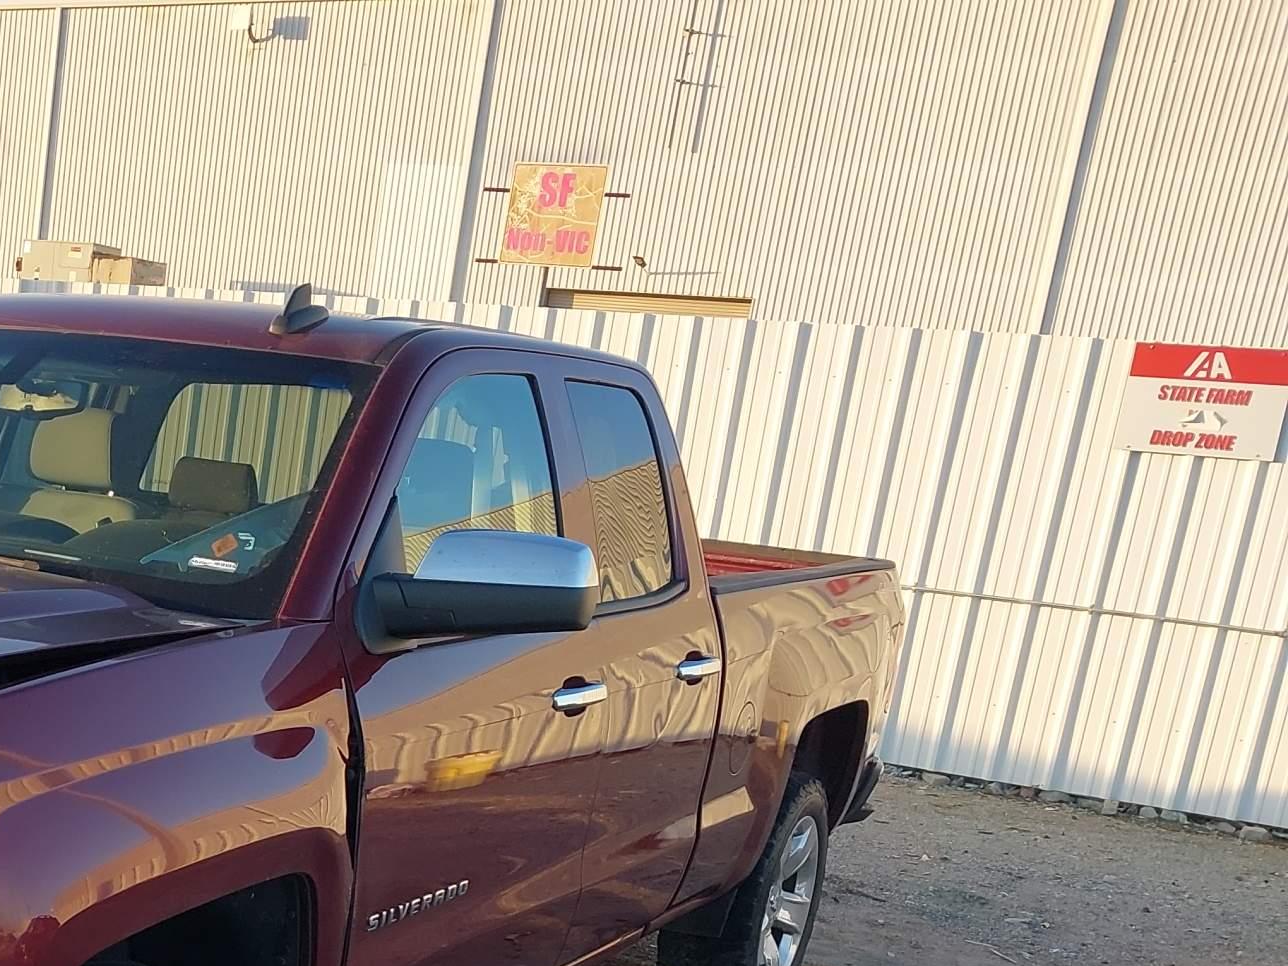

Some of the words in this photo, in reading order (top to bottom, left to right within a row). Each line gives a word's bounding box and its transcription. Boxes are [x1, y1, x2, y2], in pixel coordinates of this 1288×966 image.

[538, 171, 577, 208] SF
[1158, 384, 1205, 403] STATE
[1205, 388, 1254, 406] FARM
[1149, 429, 1194, 448] DROP
[1194, 433, 1238, 451] ZONE
[367, 879, 470, 932] SILVERADO
